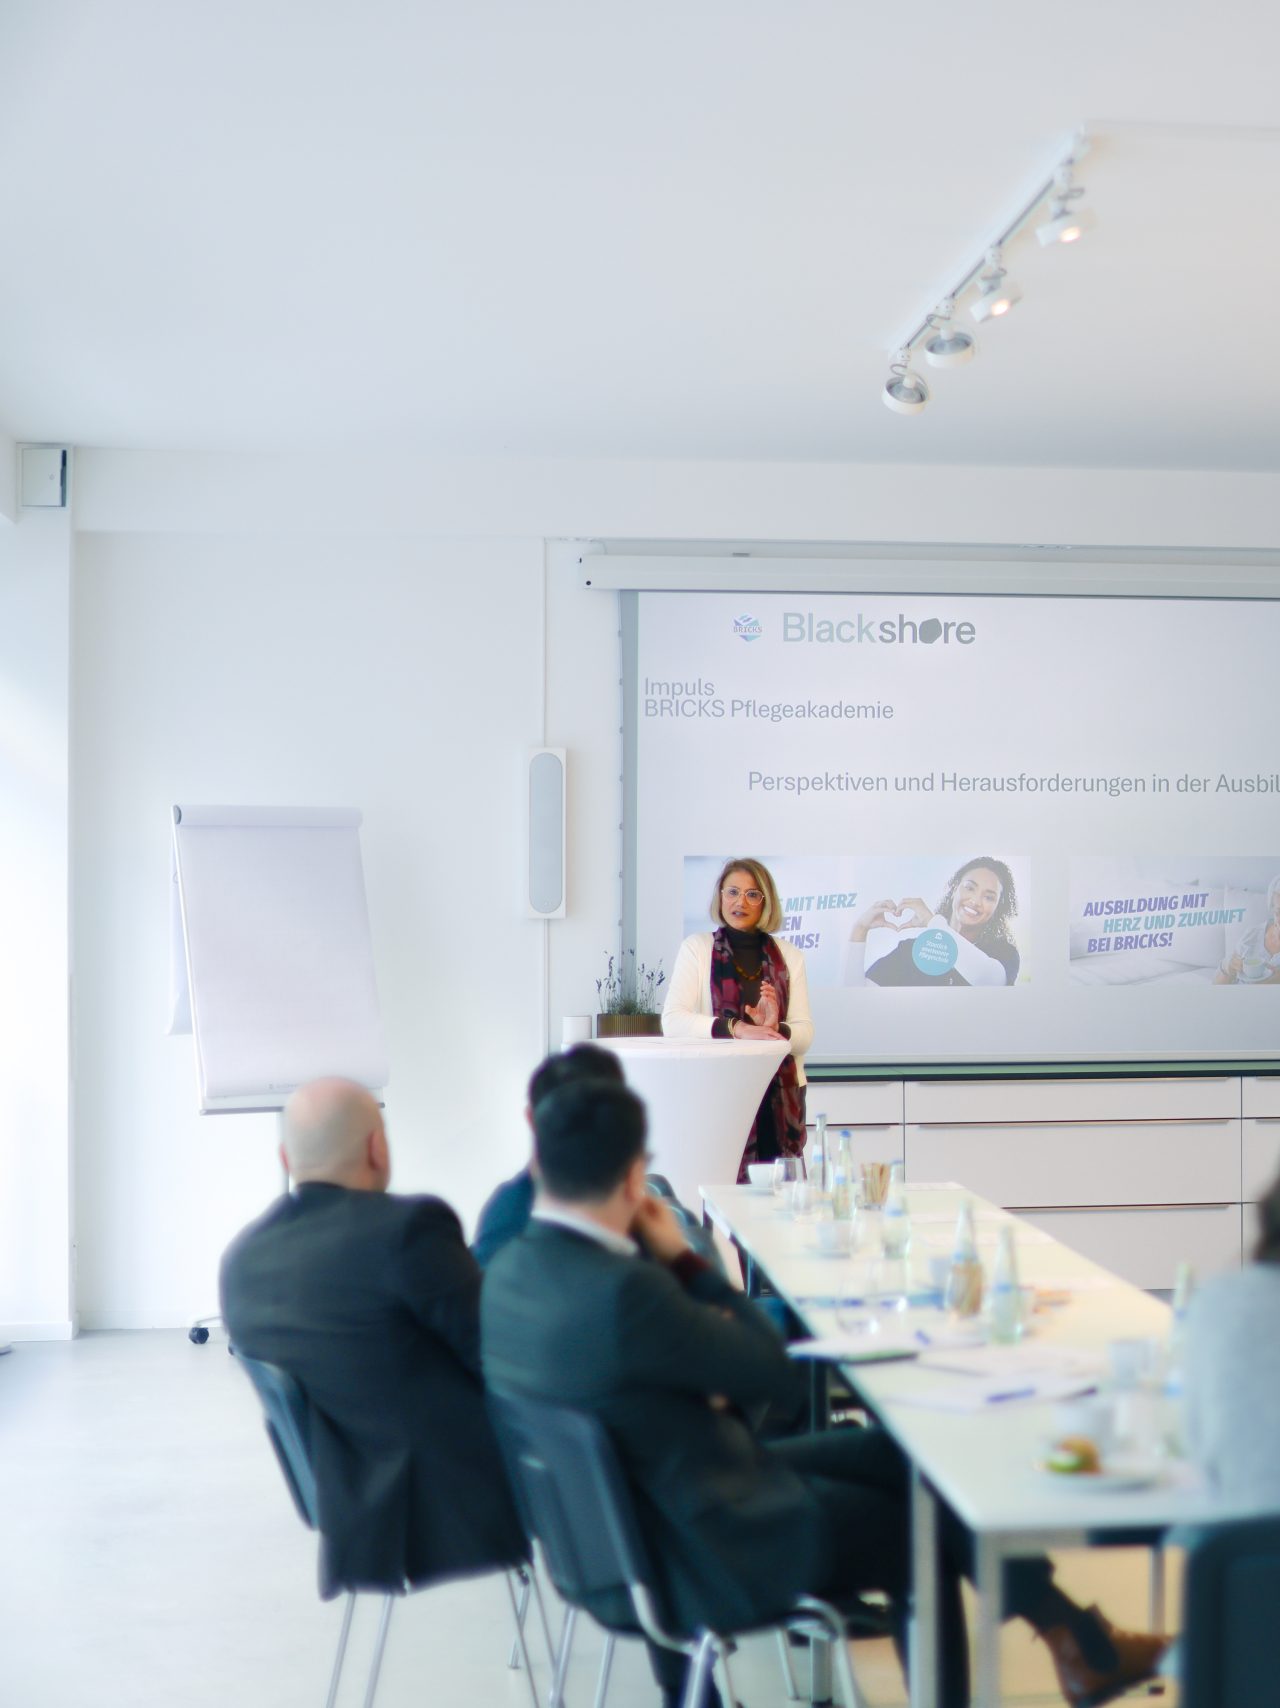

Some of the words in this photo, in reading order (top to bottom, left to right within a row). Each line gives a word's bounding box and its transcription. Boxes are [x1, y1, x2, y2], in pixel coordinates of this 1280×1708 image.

[783, 612, 976, 644] Blackshore
[645, 678, 715, 699] Impuls
[645, 699, 725, 718] BRICKS
[731, 700, 894, 722] Pflegeakademie
[748, 772, 888, 795] Perspektiven
[894, 773, 934, 791] und
[941, 773, 1146, 797] Herausforderungen
[1152, 774, 1170, 792] in
[1176, 774, 1211, 792] der
[785, 896, 815, 912] MIT
[816, 893, 858, 910] HERZ
[1083, 895, 1178, 917] AUSBILDUNG
[1180, 893, 1209, 909] MIT
[1103, 916, 1141, 933] HERZ
[1143, 914, 1175, 930] UND
[1177, 908, 1246, 928] ZUKUNFT
[1087, 937, 1111, 953] BEI
[1113, 932, 1173, 951] BRICKS!
